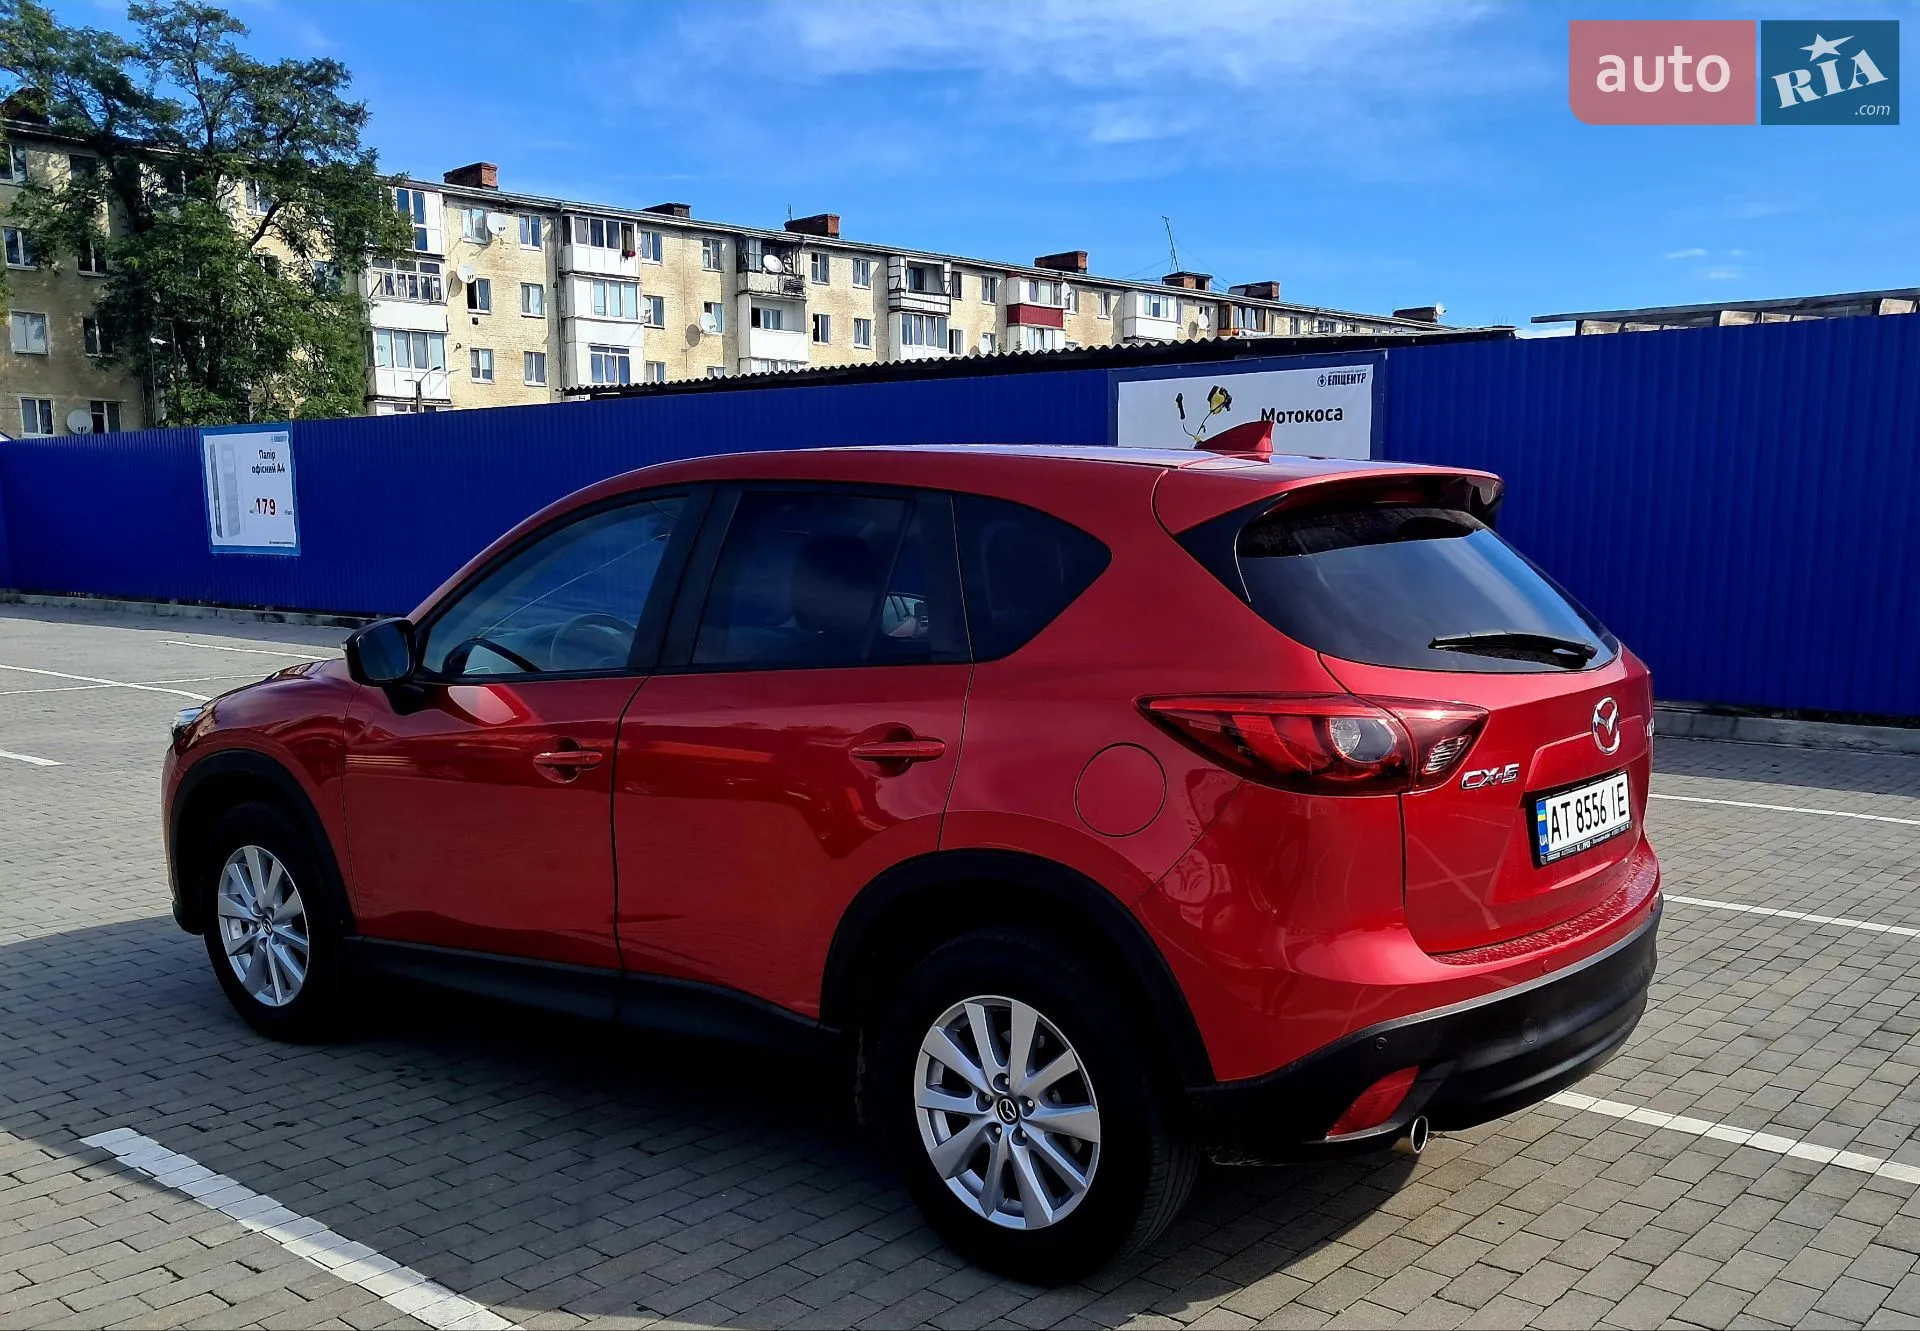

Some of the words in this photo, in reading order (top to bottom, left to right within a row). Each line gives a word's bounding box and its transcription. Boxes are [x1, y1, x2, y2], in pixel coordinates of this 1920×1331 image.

[1327, 372, 1367, 386] ЕПІЦЕНТР
[1260, 407, 1343, 424] Мотокоса
[258, 448, 276, 461] Папір
[251, 463, 276, 475] офісний
[256, 498, 276, 516] 179
[1460, 763, 1520, 790] CX-5
[1551, 802, 1571, 844] AT
[1575, 789, 1607, 833] 8556
[1611, 782, 1627, 821] IE
